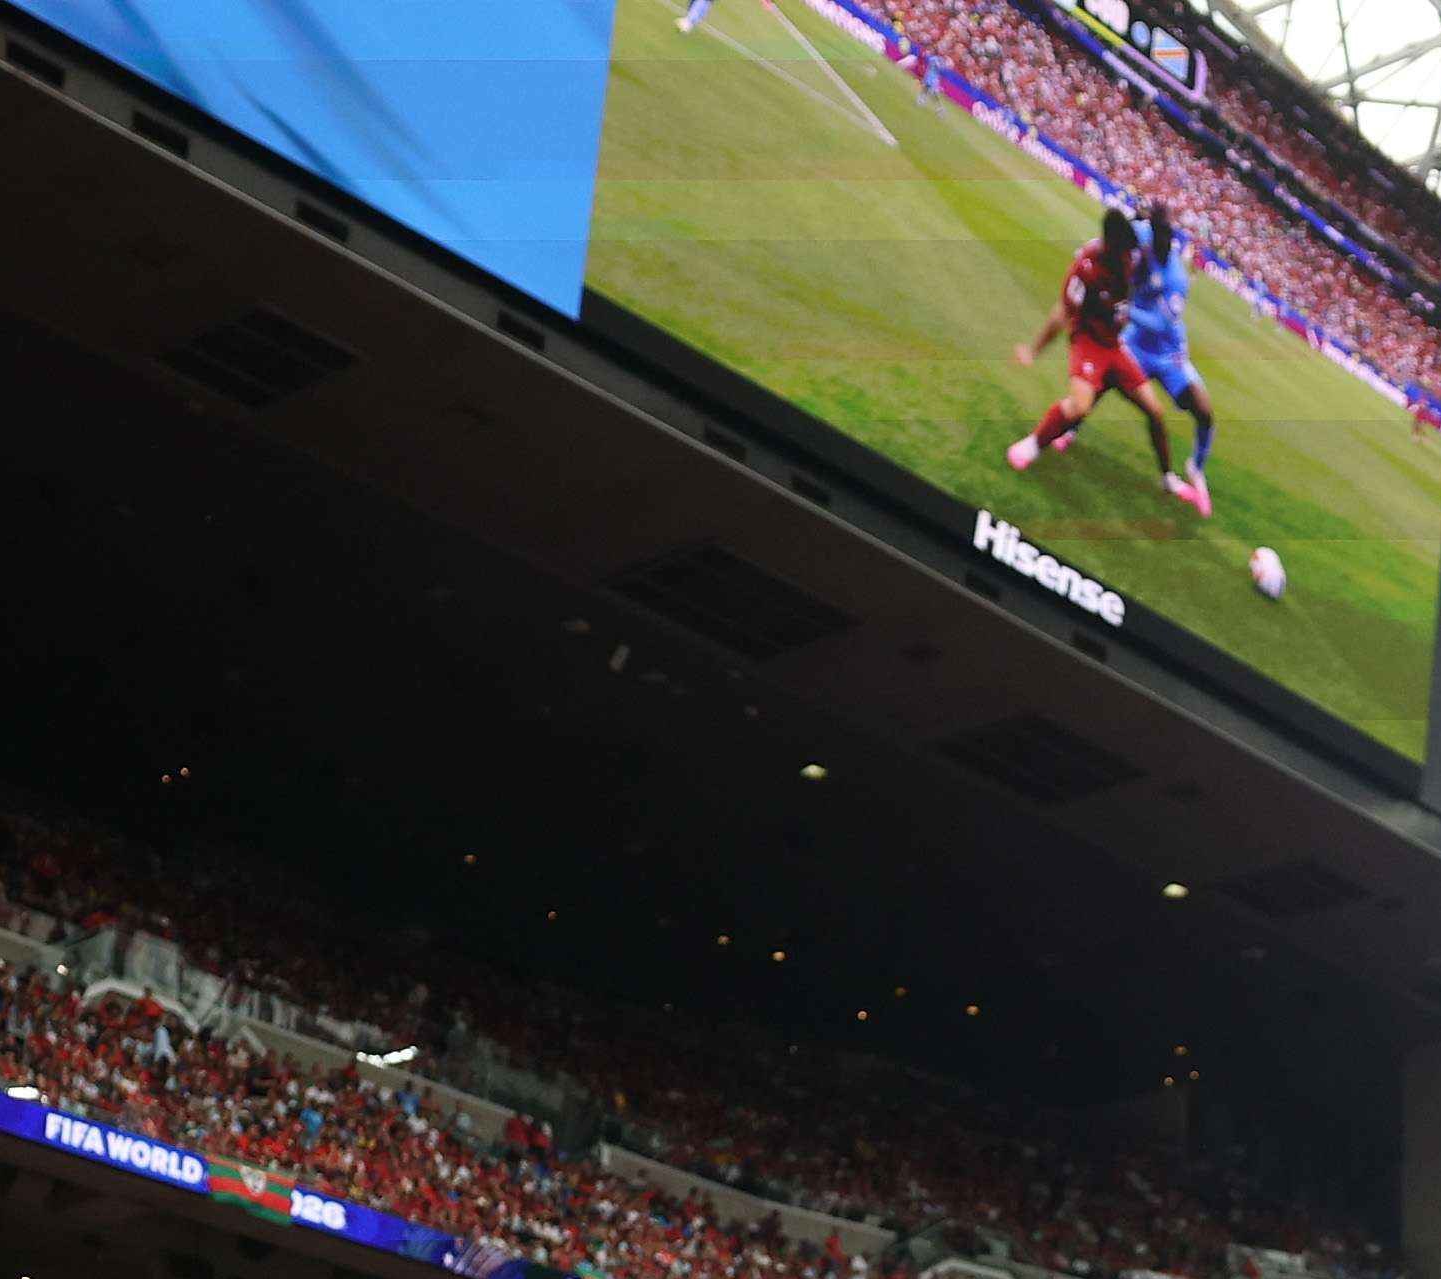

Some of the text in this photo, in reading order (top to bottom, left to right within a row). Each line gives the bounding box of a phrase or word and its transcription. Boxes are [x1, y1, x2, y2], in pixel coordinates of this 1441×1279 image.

[974, 510, 1125, 627] Hisense
[45, 1112, 105, 1157] FIFA
[106, 1131, 205, 1185] WORLD
